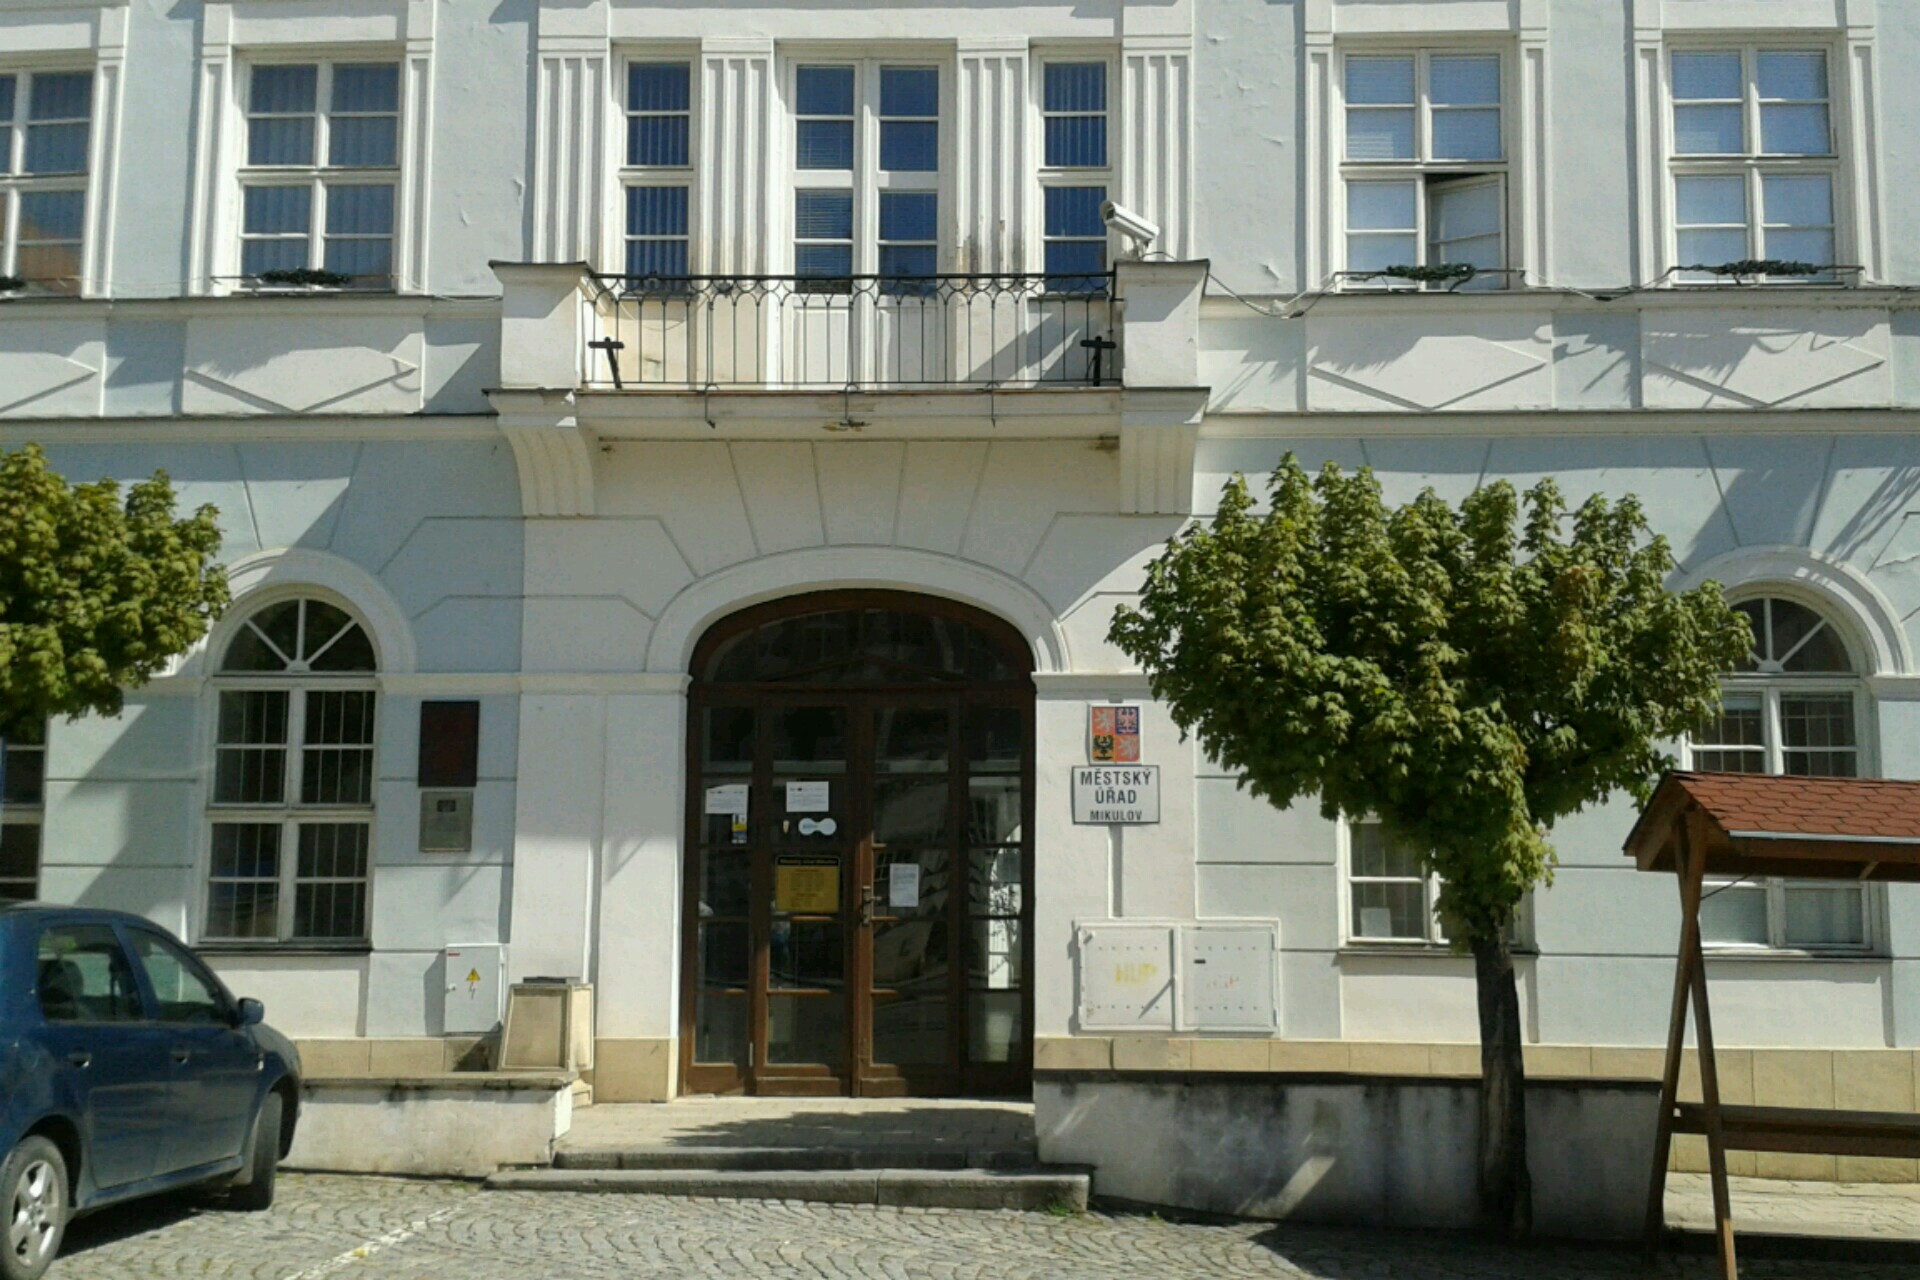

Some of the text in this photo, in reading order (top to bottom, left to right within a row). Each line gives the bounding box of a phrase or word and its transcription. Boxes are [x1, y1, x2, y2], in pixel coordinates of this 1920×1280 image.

[1080, 768, 1151, 785] MĚSTSKÝ
[1095, 786, 1137, 804] ÚŘAD
[1090, 810, 1142, 821] MIKULOV
